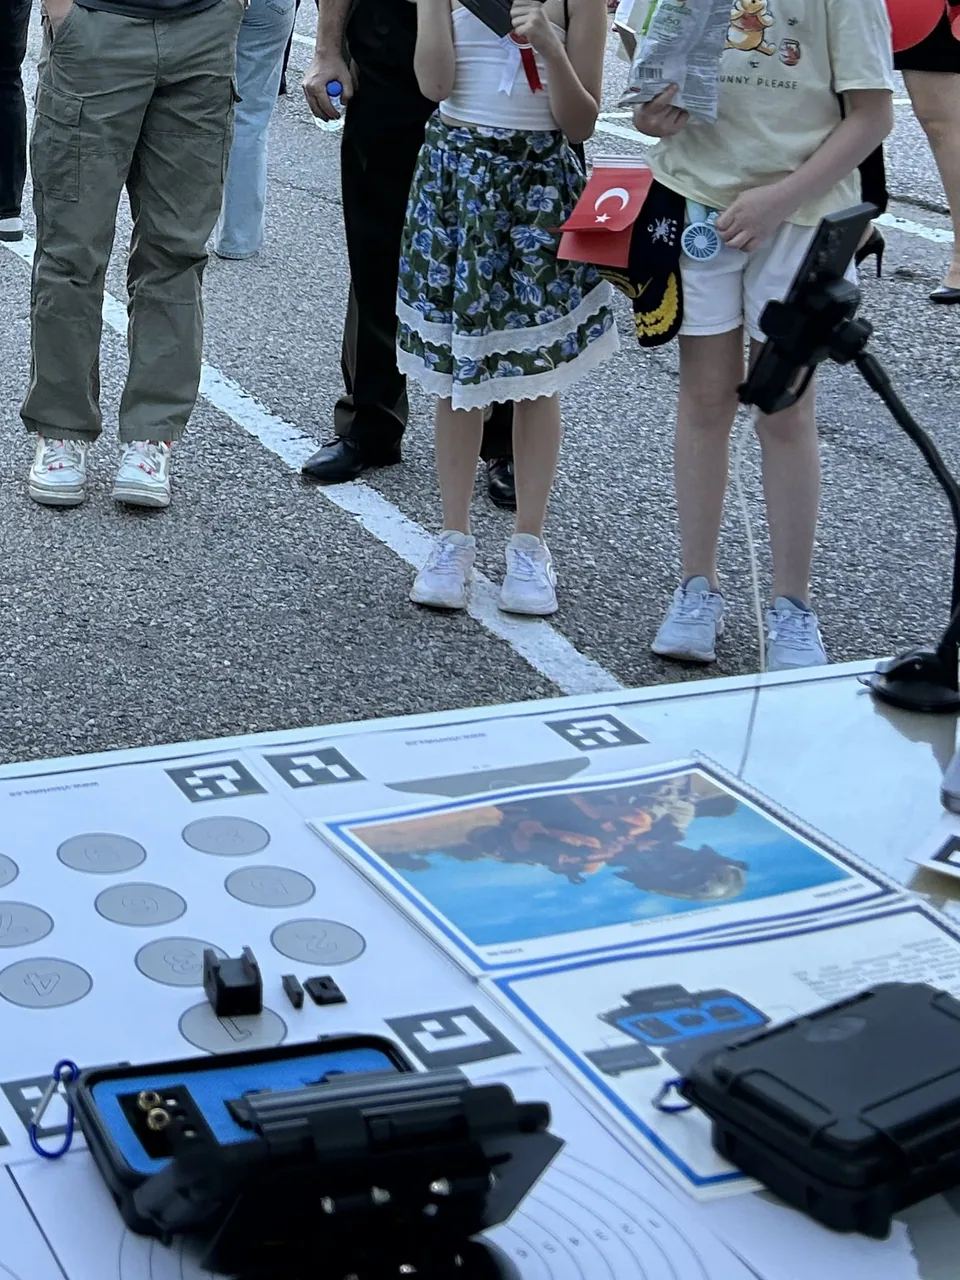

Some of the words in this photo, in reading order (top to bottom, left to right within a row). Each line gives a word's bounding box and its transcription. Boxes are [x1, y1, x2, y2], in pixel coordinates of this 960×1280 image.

[757, 77, 798, 90] PLEASE
[163, 949, 202, 975] 3
[23, 972, 62, 997] 4
